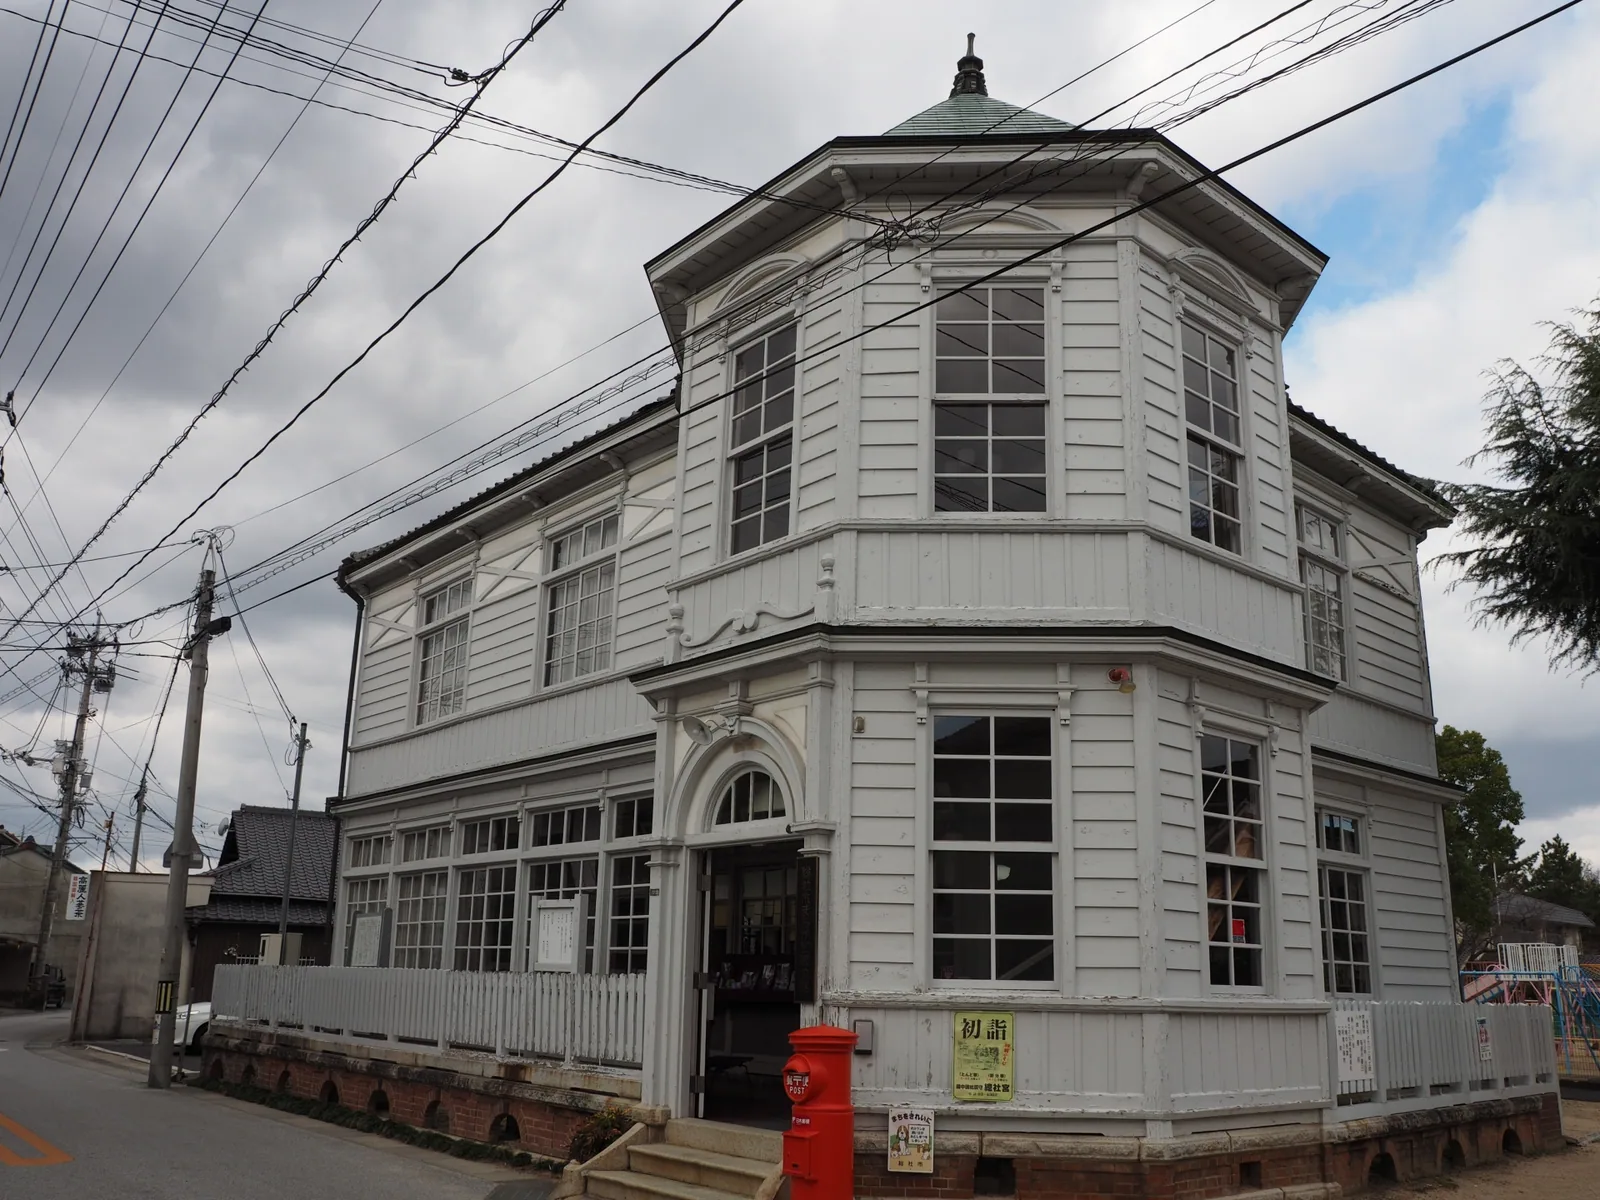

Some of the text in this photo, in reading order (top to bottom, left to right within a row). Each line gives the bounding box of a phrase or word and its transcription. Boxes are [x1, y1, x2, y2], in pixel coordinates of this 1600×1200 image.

[961, 1018, 1007, 1040] 初詣
[789, 1086, 805, 1094] POST
[891, 1112, 932, 1124] まちをきれいに
